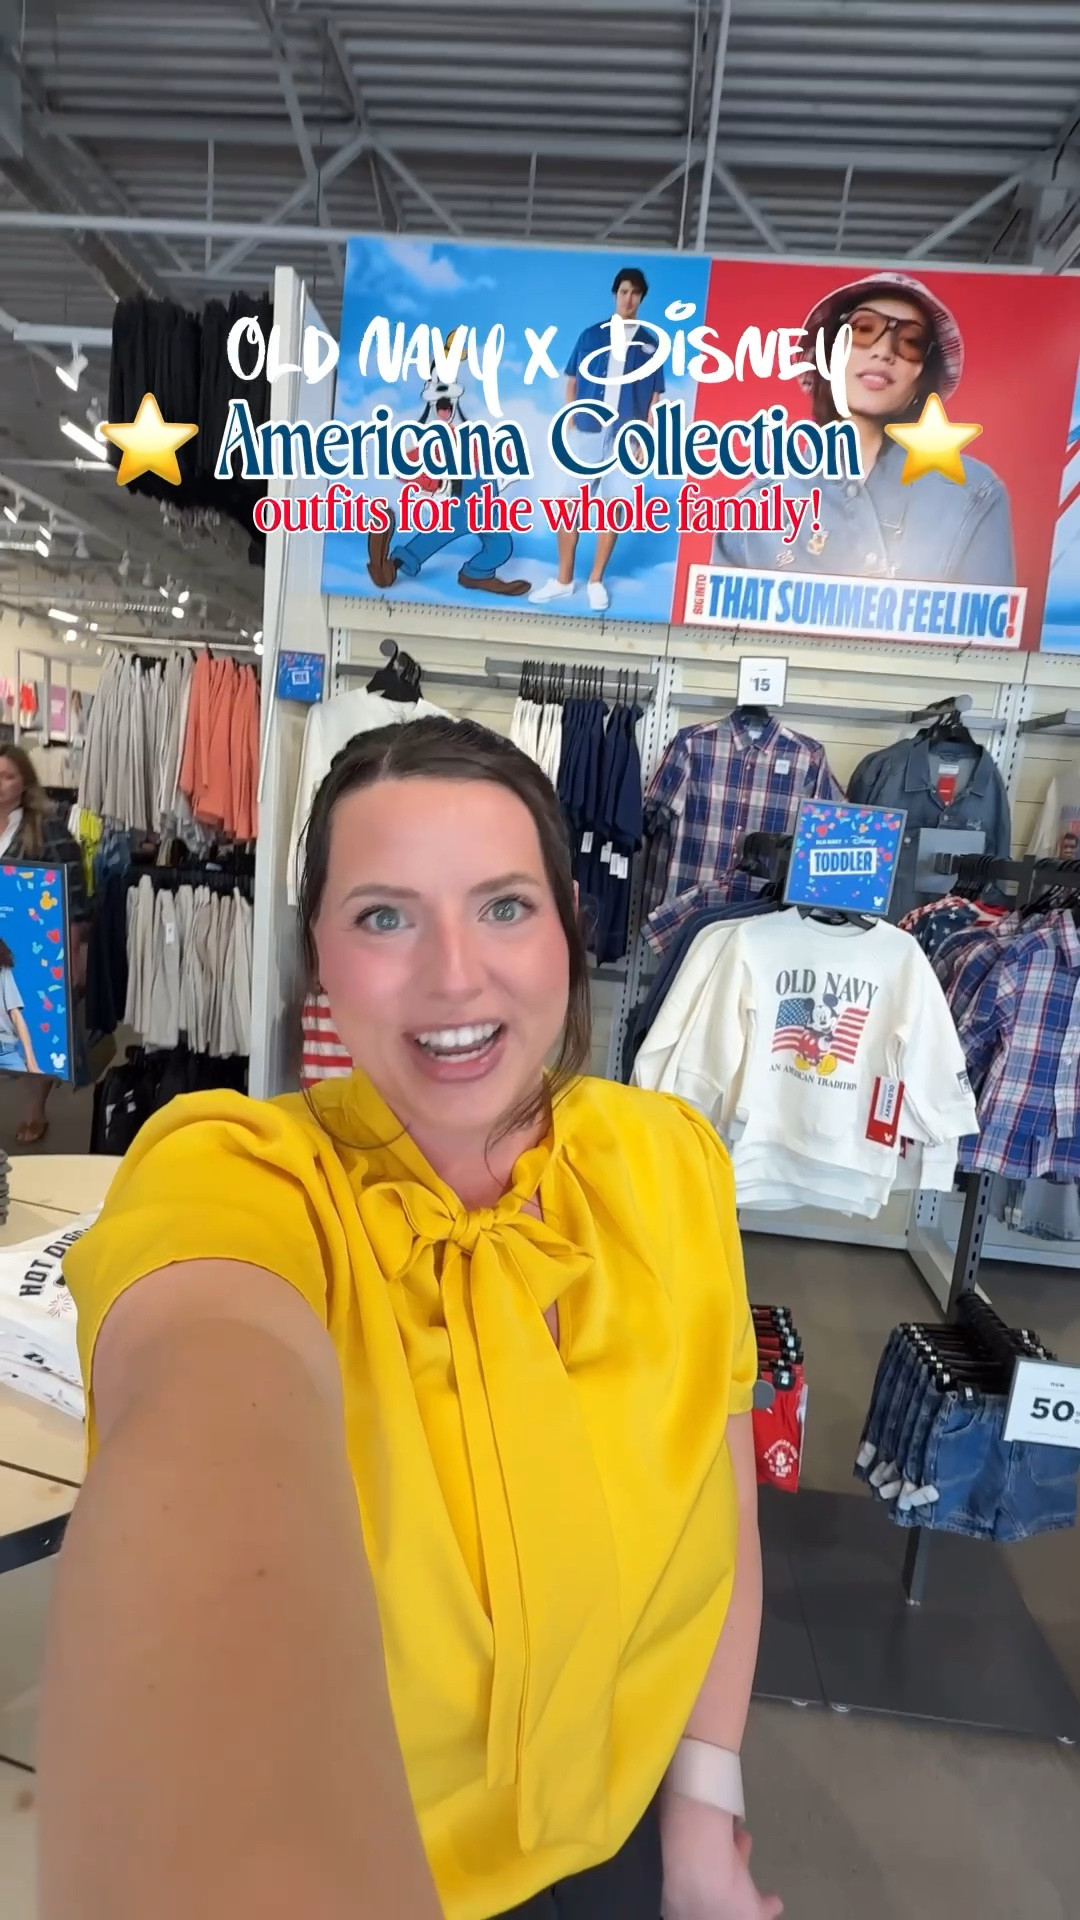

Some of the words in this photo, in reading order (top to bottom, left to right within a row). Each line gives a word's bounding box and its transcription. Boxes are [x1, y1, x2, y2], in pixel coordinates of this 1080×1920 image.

[694, 574, 707, 597] INTO
[708, 574, 776, 621] THAT
[775, 579, 898, 631] SUMMER
[897, 588, 1020, 639] FEELING!
[814, 851, 873, 872] TODDLER
[775, 968, 816, 996] OLD
[823, 971, 879, 1009] NAVY
[769, 1063, 781, 1072] AN
[783, 1064, 815, 1083] AMERICAN
[817, 1078, 858, 1091] TRADITION
[19, 1259, 53, 1297] HOT
[43, 1228, 89, 1259] DIG
[1030, 1396, 1075, 1422] 50
